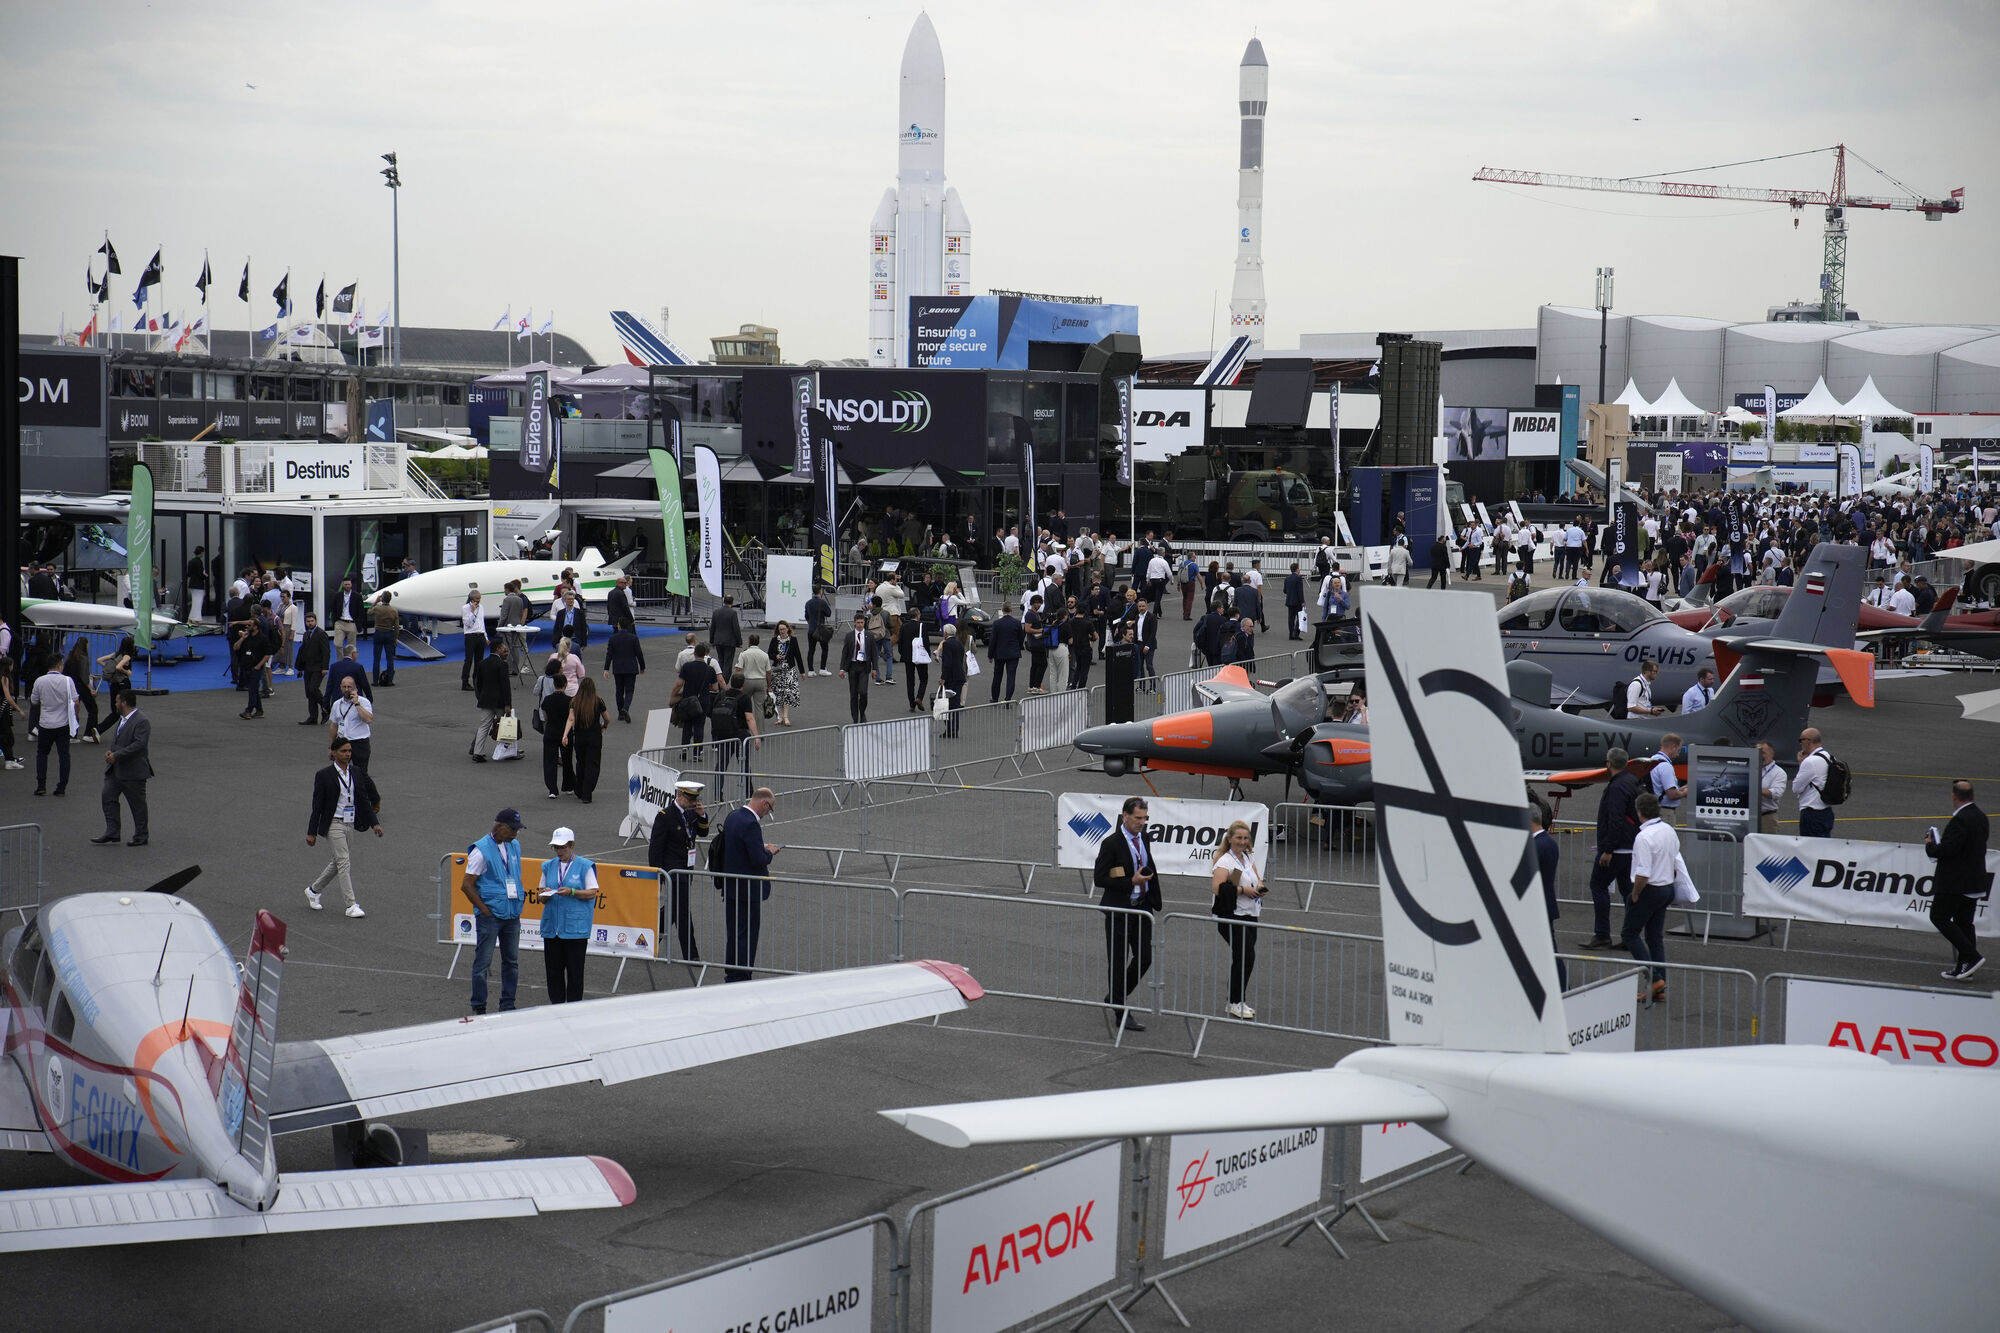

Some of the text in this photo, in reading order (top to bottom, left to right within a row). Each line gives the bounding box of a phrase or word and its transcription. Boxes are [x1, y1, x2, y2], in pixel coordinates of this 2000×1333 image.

[1060, 318, 1089, 328] BOEING
[917, 326, 977, 340] Ensuring a
[917, 342, 987, 352] more secure
[917, 353, 952, 366] future
[19, 376, 69, 404] OM
[1745, 398, 1804, 408] MED CENT
[130, 414, 149, 427] BOOM
[223, 414, 240, 427] BOOM
[302, 415, 316, 427] BOOM
[1512, 416, 1557, 432] MBDA
[820, 543, 834, 585] DUC
[1624, 643, 1698, 666] OE-VHS
[1705, 796, 1740, 805] DA62 MPP
[1389, 962, 1434, 984] GAILLARD ASA
[1392, 985, 1407, 998] 1204
[1585, 1026, 1592, 1043] &
[1592, 1013, 1631, 1039] GAILLARD
[70, 1071, 144, 1172] F-GHYX
[1216, 1127, 1318, 1177] TURGIS & GAILLARD
[1213, 1176, 1248, 1197] GROUPE
[962, 1199, 1095, 1294] AAROK
[774, 1286, 860, 1333] GAILLARD
